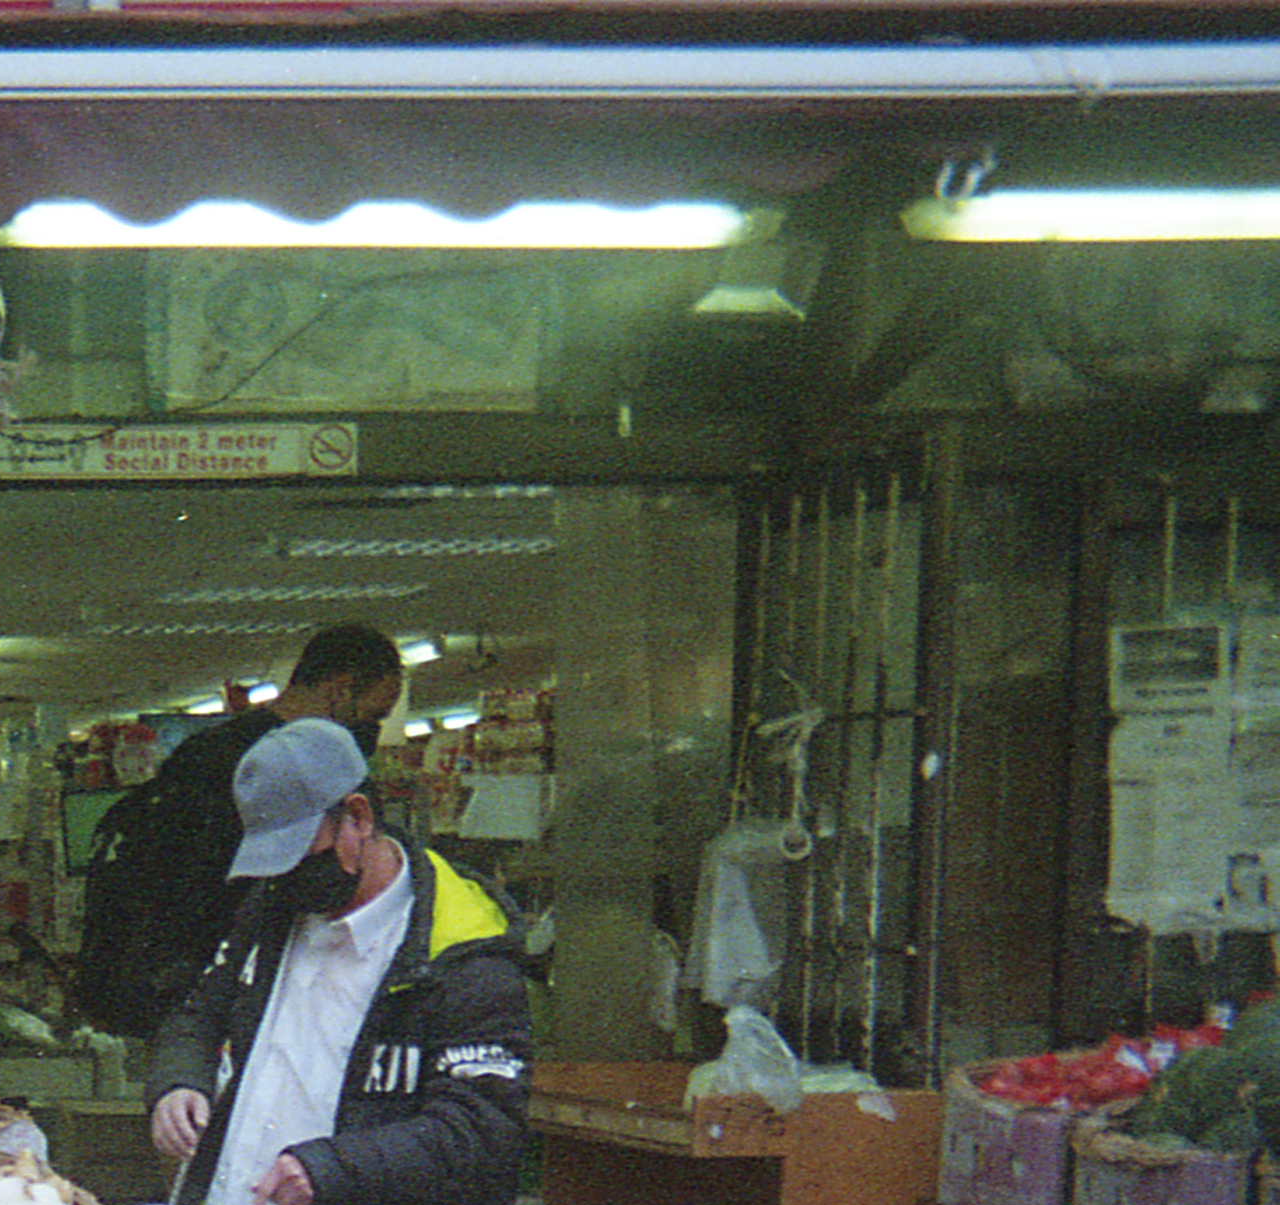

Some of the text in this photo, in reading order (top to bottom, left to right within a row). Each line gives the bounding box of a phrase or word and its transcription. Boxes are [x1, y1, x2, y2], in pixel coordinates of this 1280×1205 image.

[100, 431, 278, 452] Maintain 2 meter
[104, 453, 269, 472] Social Distance
